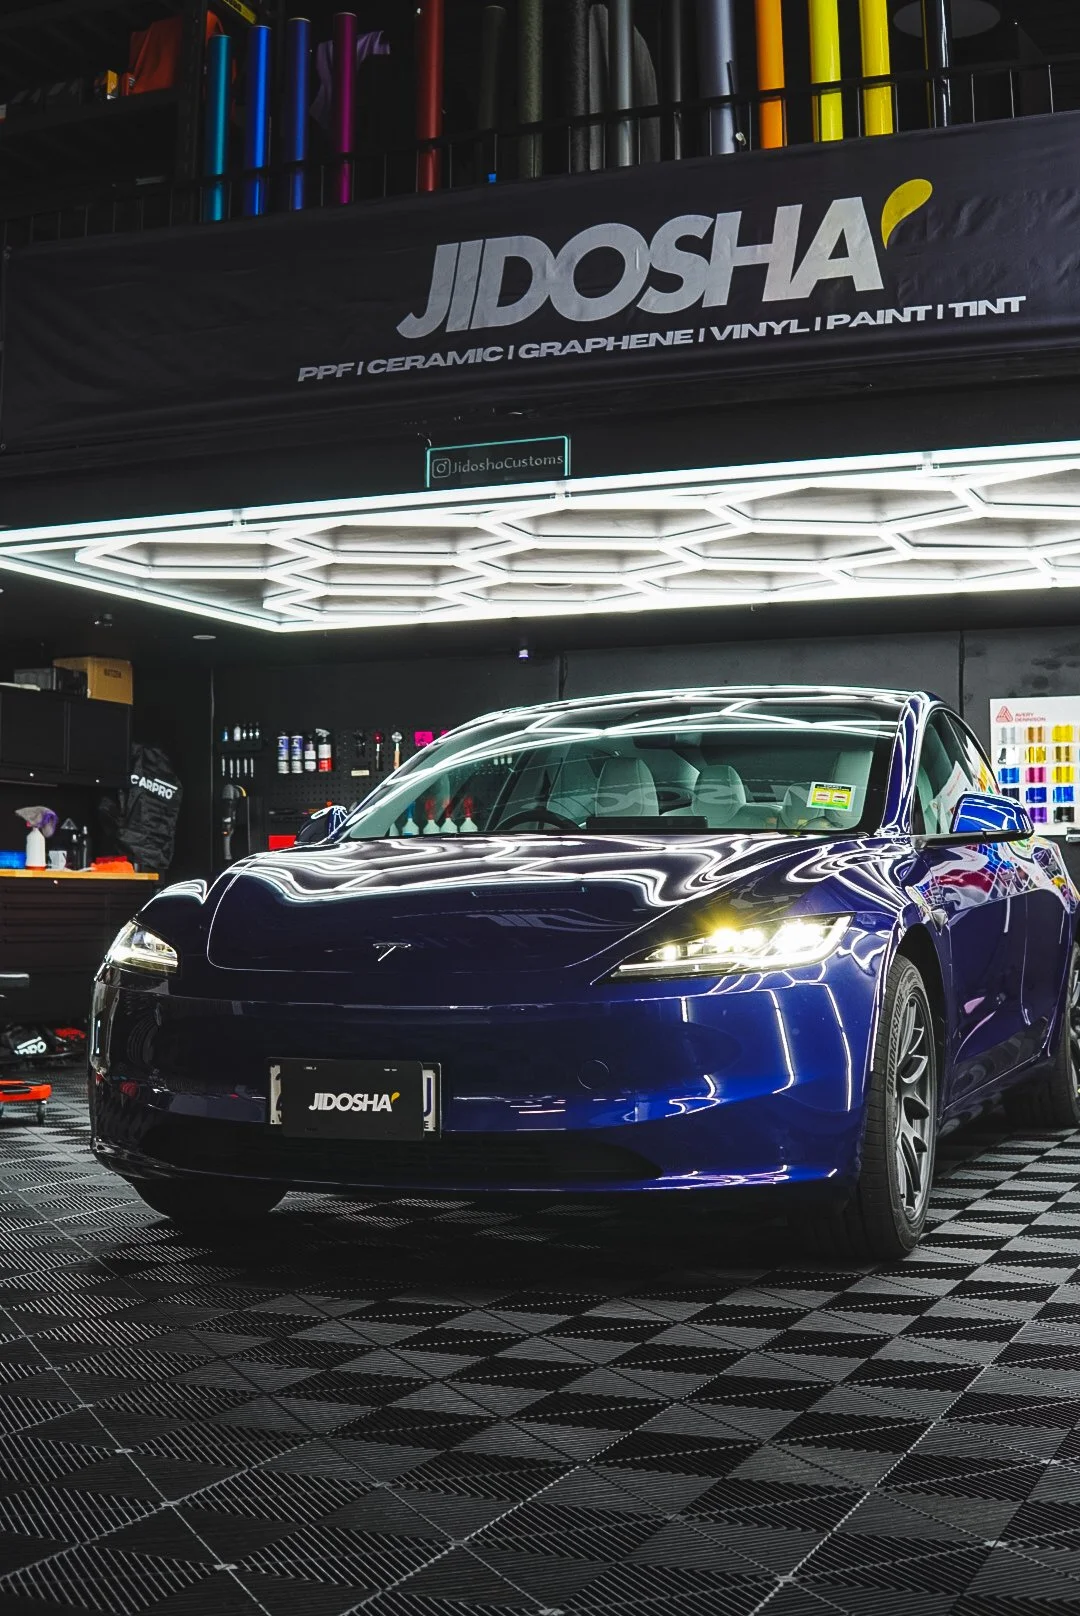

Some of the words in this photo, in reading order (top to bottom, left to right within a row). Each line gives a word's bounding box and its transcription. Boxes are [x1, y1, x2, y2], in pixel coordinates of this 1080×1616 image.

[297, 361, 354, 382] PPF
[366, 346, 503, 375] CERAMIC
[518, 328, 694, 360] GRAPHENE
[709, 320, 810, 341] VINYL
[826, 305, 934, 331] PAINT
[948, 295, 1027, 317] TINT
[130, 774, 173, 800] CARPRO
